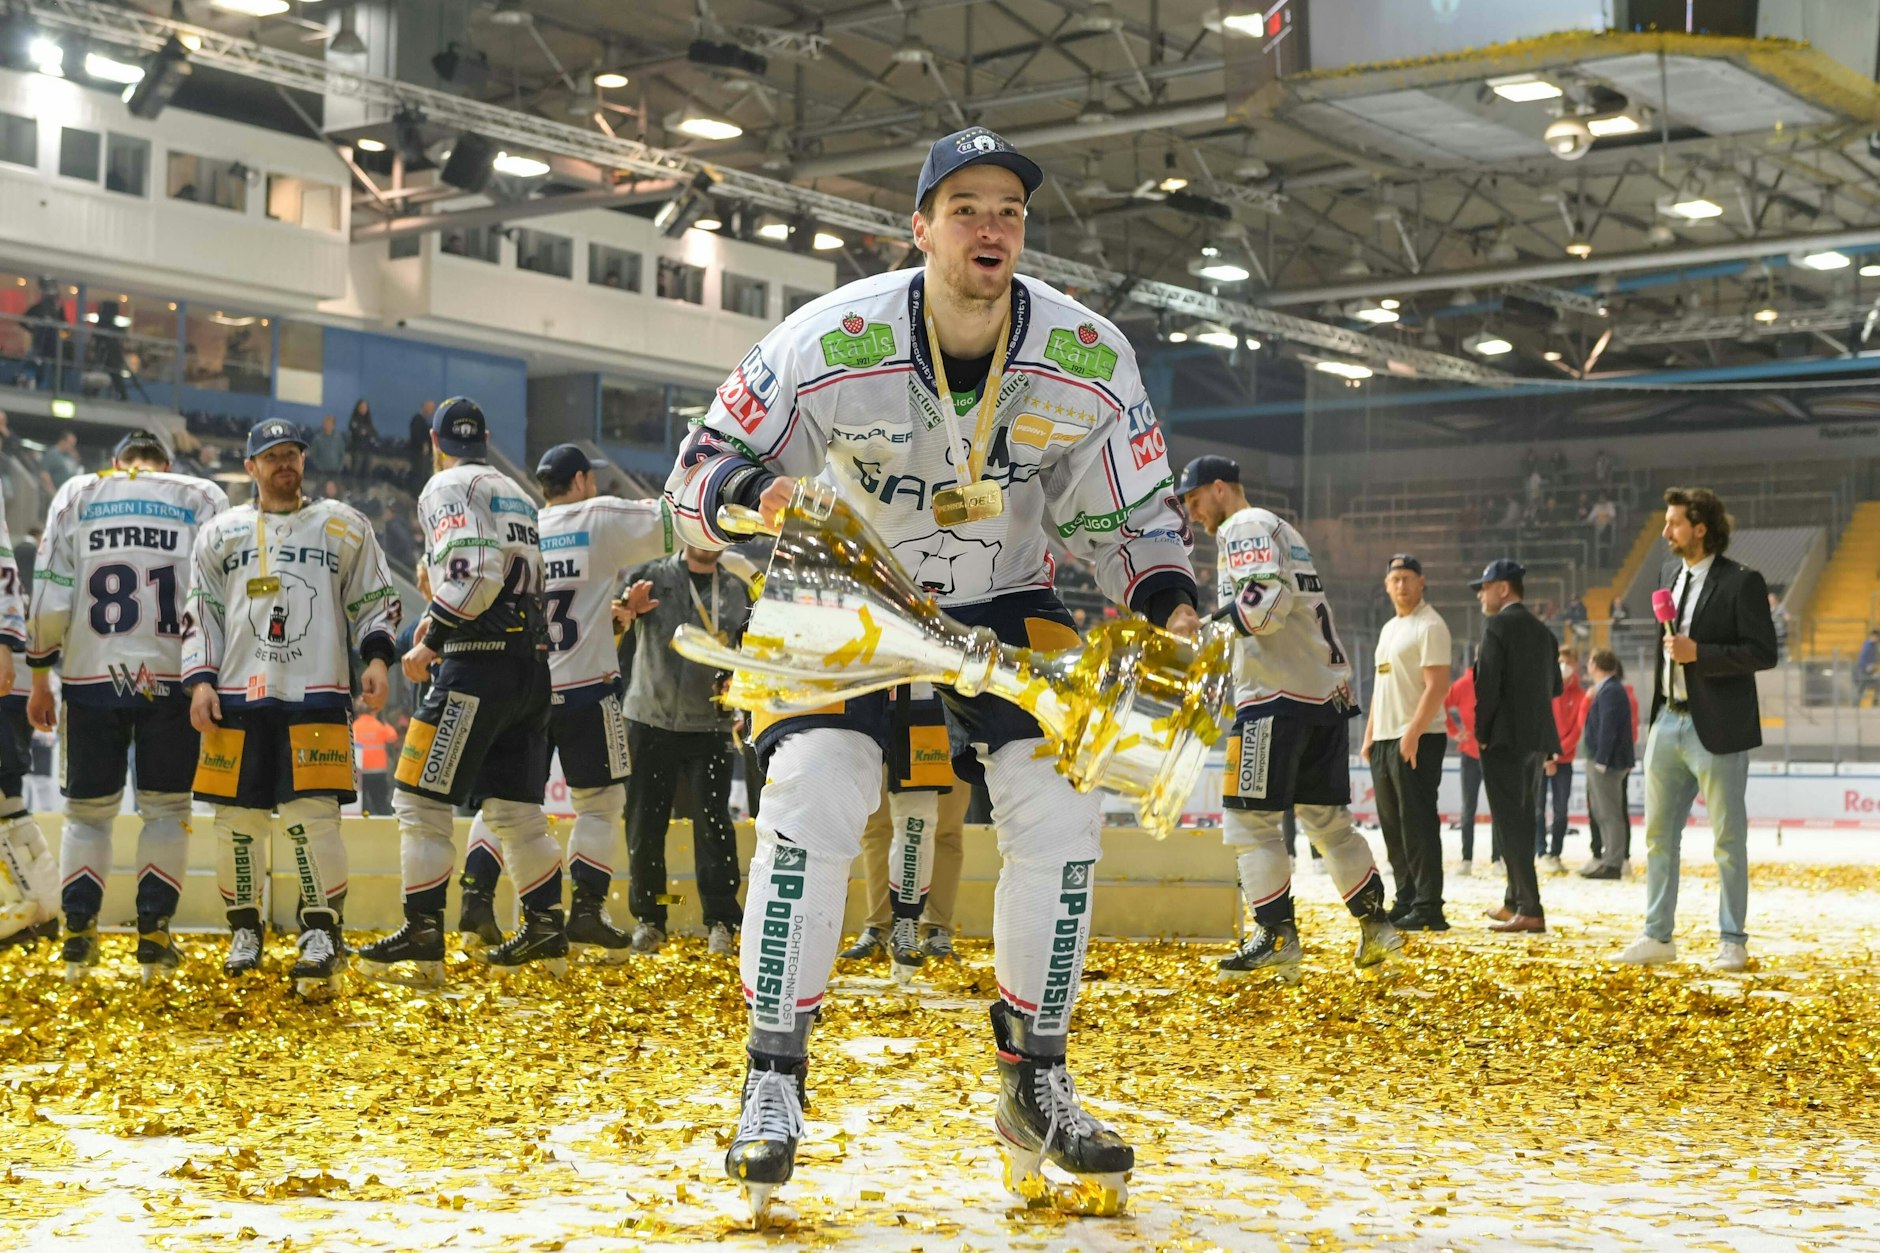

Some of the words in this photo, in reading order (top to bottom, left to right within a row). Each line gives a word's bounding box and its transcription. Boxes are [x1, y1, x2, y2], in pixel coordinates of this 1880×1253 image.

[826, 331, 892, 361] Karls
[856, 357, 871, 366] 1921
[1071, 364, 1086, 375] 1921
[909, 377, 942, 425] ructure
[1128, 400, 1158, 441] LIQ
[1131, 426, 1167, 468] MO
[1084, 517, 1112, 530] LIGO
[89, 526, 178, 551] STREU
[540, 535, 577, 551] STROM
[1229, 536, 1270, 555] LIQUI
[544, 559, 581, 580] ERL
[1230, 549, 1272, 567] MOLY
[86, 561, 182, 639] 81
[1242, 579, 1268, 608] 5
[543, 588, 580, 652] 3
[254, 647, 304, 665] BERLIN
[443, 641, 507, 654] WARRIOR
[424, 697, 462, 784] CONTIPARK
[1240, 719, 1258, 792] CONTIPAR
[782, 914, 804, 1000] DACHTECHNIK
[782, 1003, 794, 1028] OST
